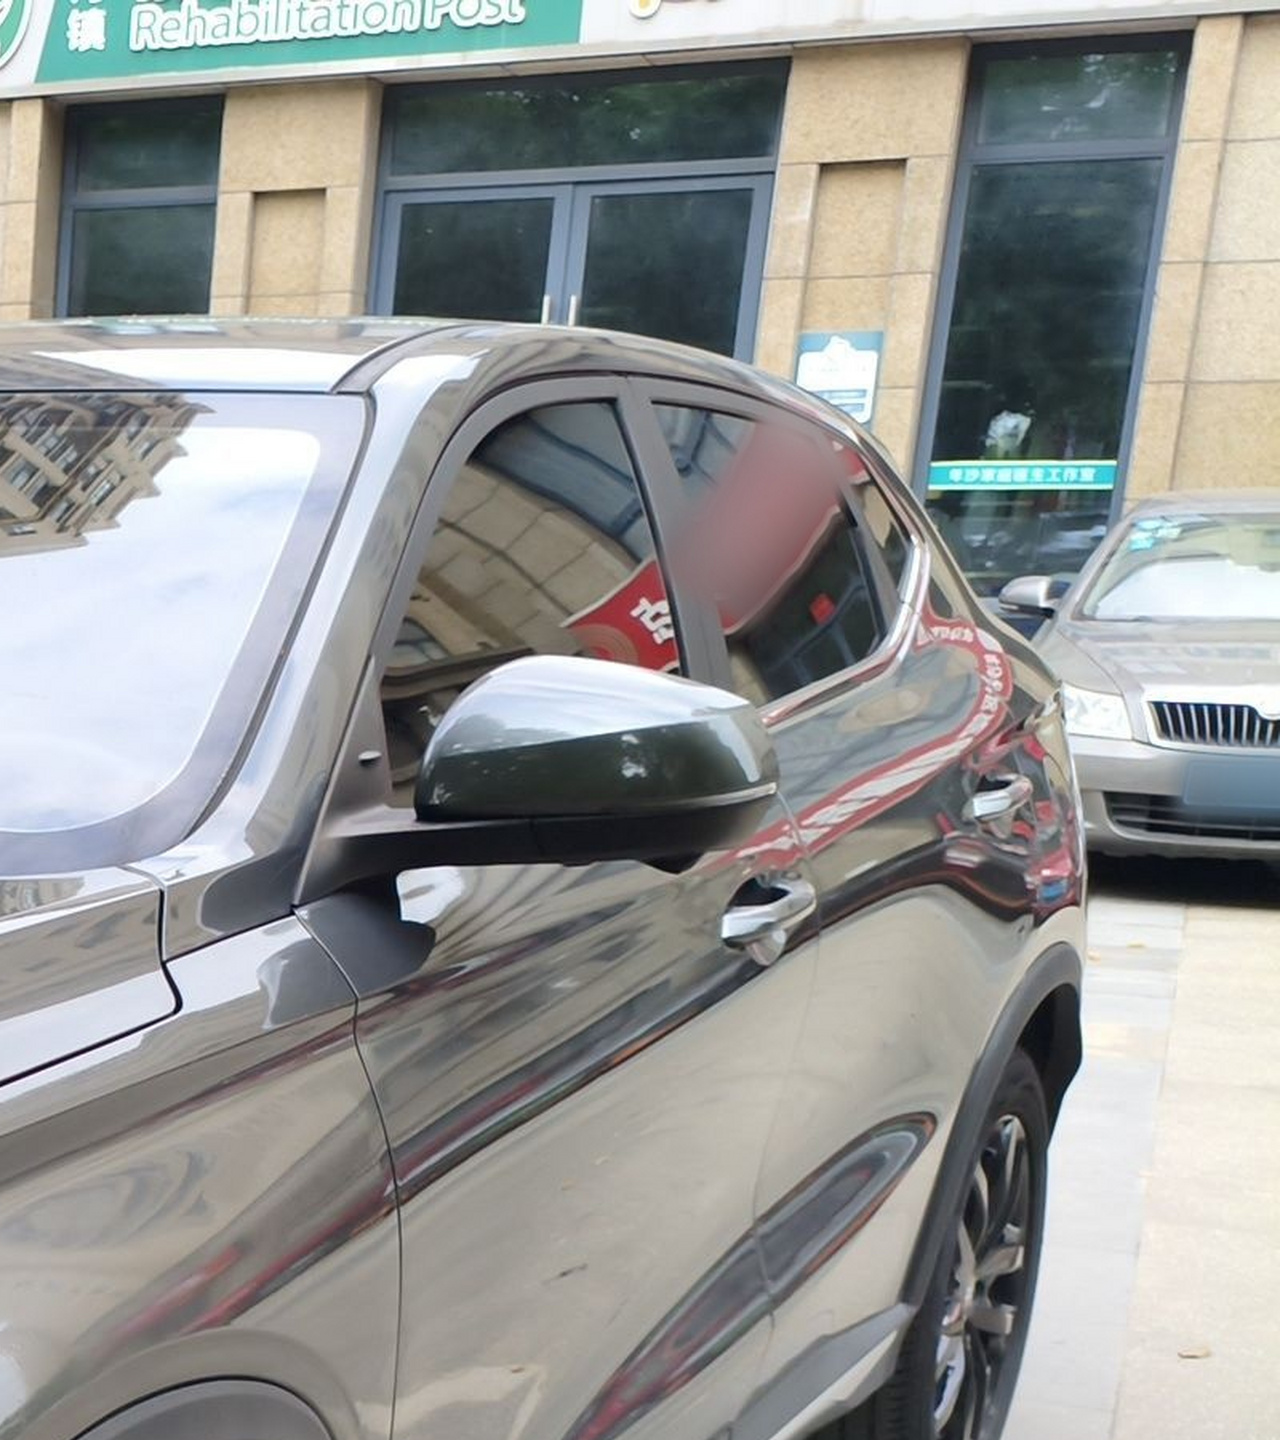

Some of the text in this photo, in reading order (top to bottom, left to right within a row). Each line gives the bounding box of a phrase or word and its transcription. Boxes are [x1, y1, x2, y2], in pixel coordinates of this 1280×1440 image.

[66, 0, 107, 52] 镇
[129, 0, 526, 51] Rehabilitation Post
